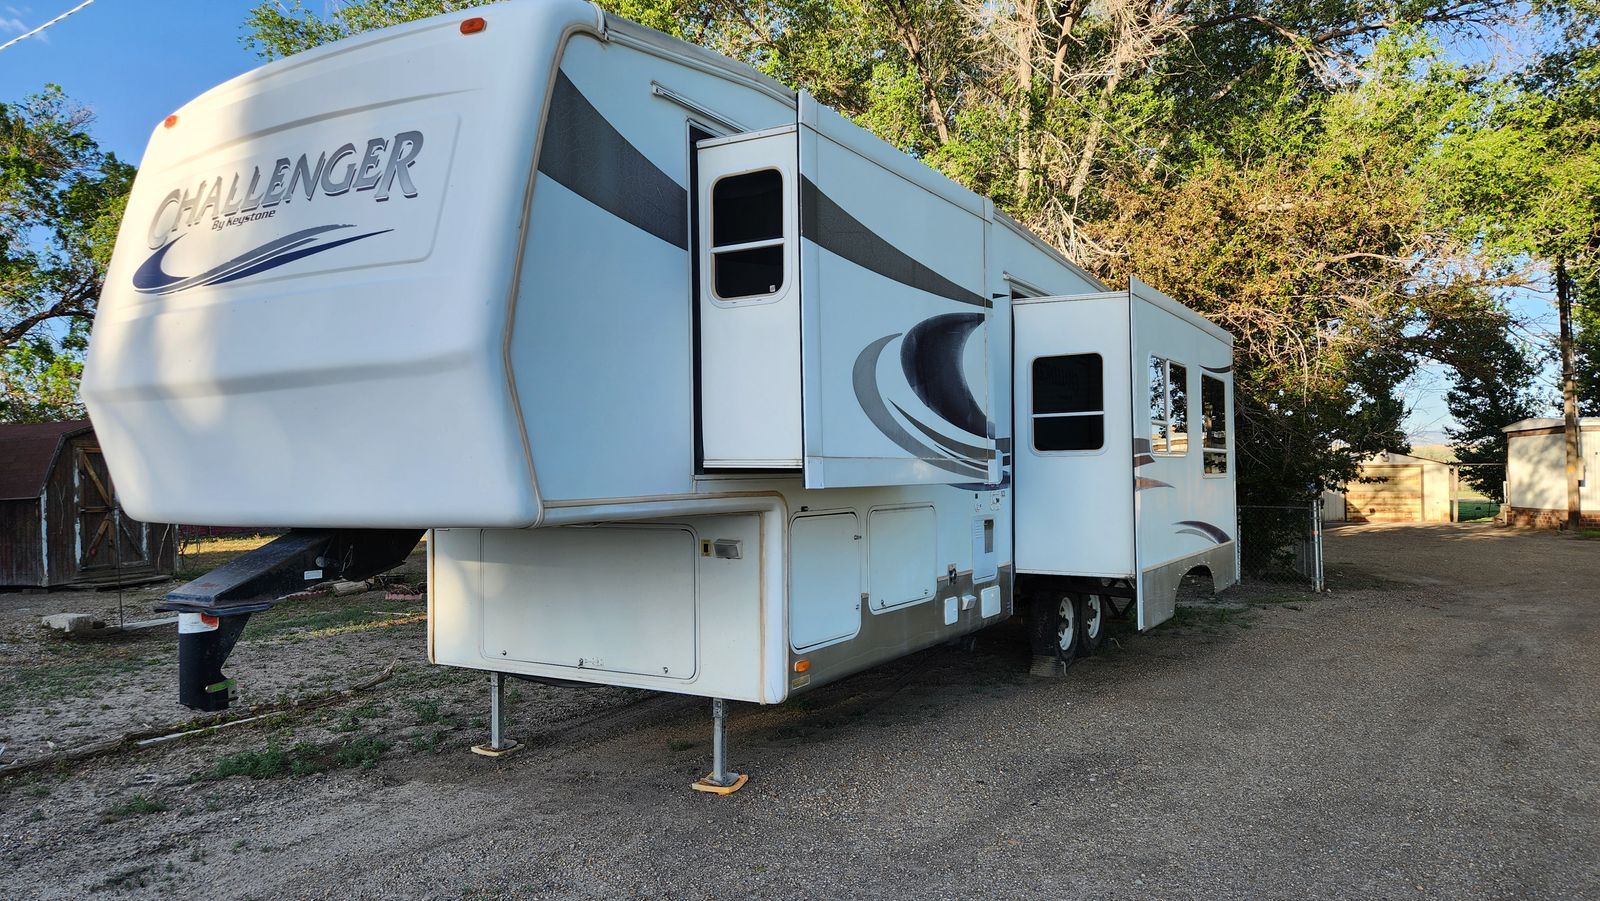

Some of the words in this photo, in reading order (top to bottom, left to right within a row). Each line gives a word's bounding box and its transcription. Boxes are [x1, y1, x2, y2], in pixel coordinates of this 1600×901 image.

[148, 130, 424, 250] CHALLENGER
[212, 220, 225, 231] By
[226, 210, 276, 226] Keystone
